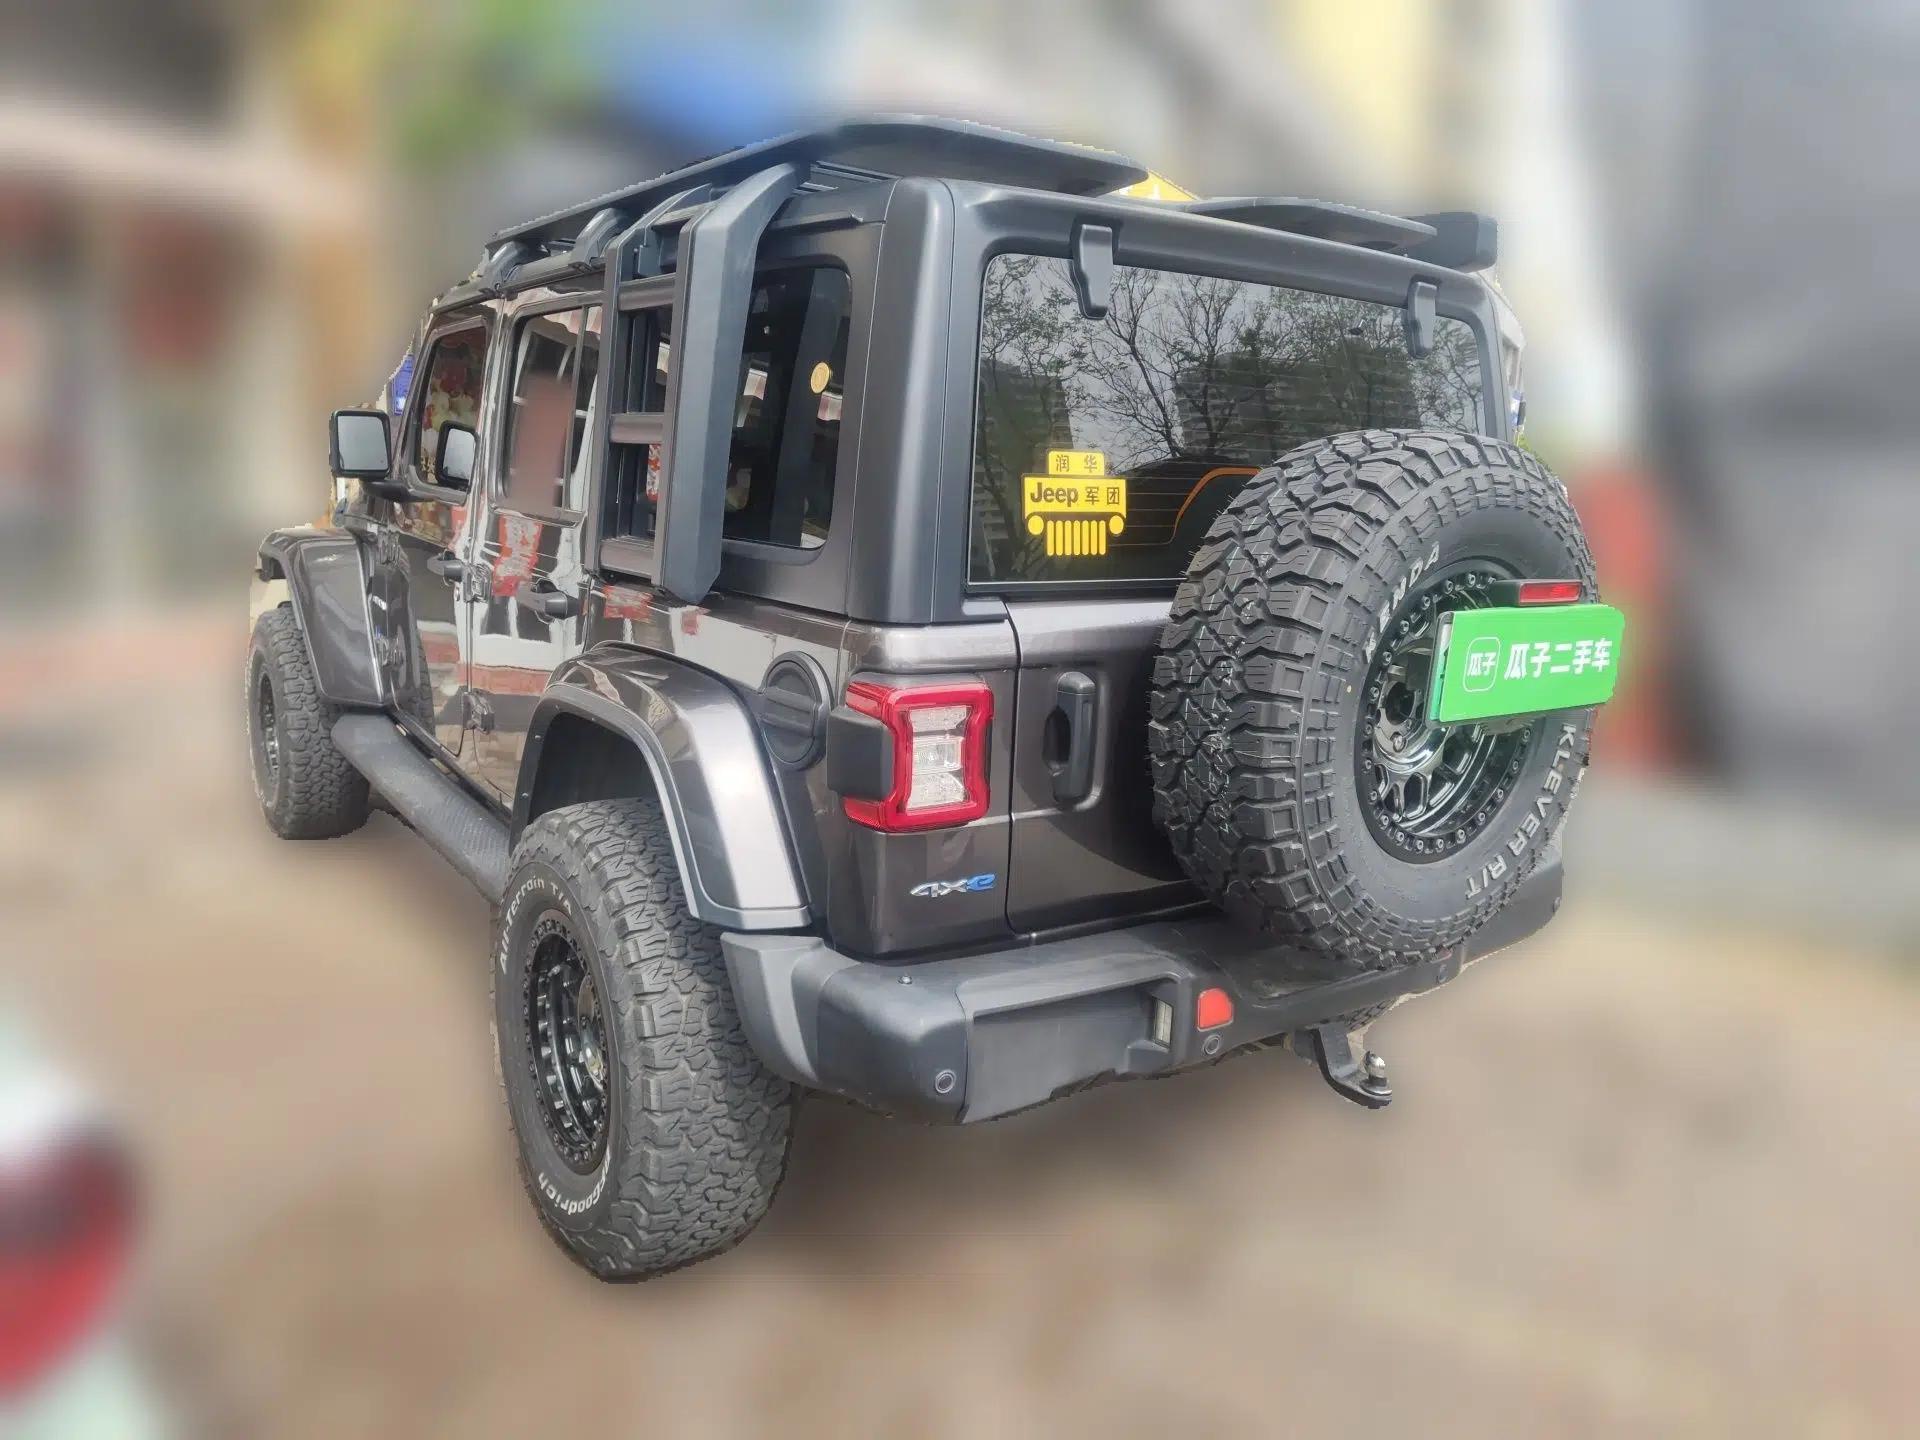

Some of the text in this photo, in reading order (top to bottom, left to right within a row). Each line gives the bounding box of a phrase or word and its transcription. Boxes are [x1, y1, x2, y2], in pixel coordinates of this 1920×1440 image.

[1056, 454, 1098, 473] 润华
[1030, 482, 1120, 507] Jeep 军团
[1467, 652, 1497, 677] 瓜子
[1504, 638, 1613, 680] 瓜子二手车
[1465, 724, 1577, 899] KLEVER R/T
[500, 875, 545, 975] All-Terrain
